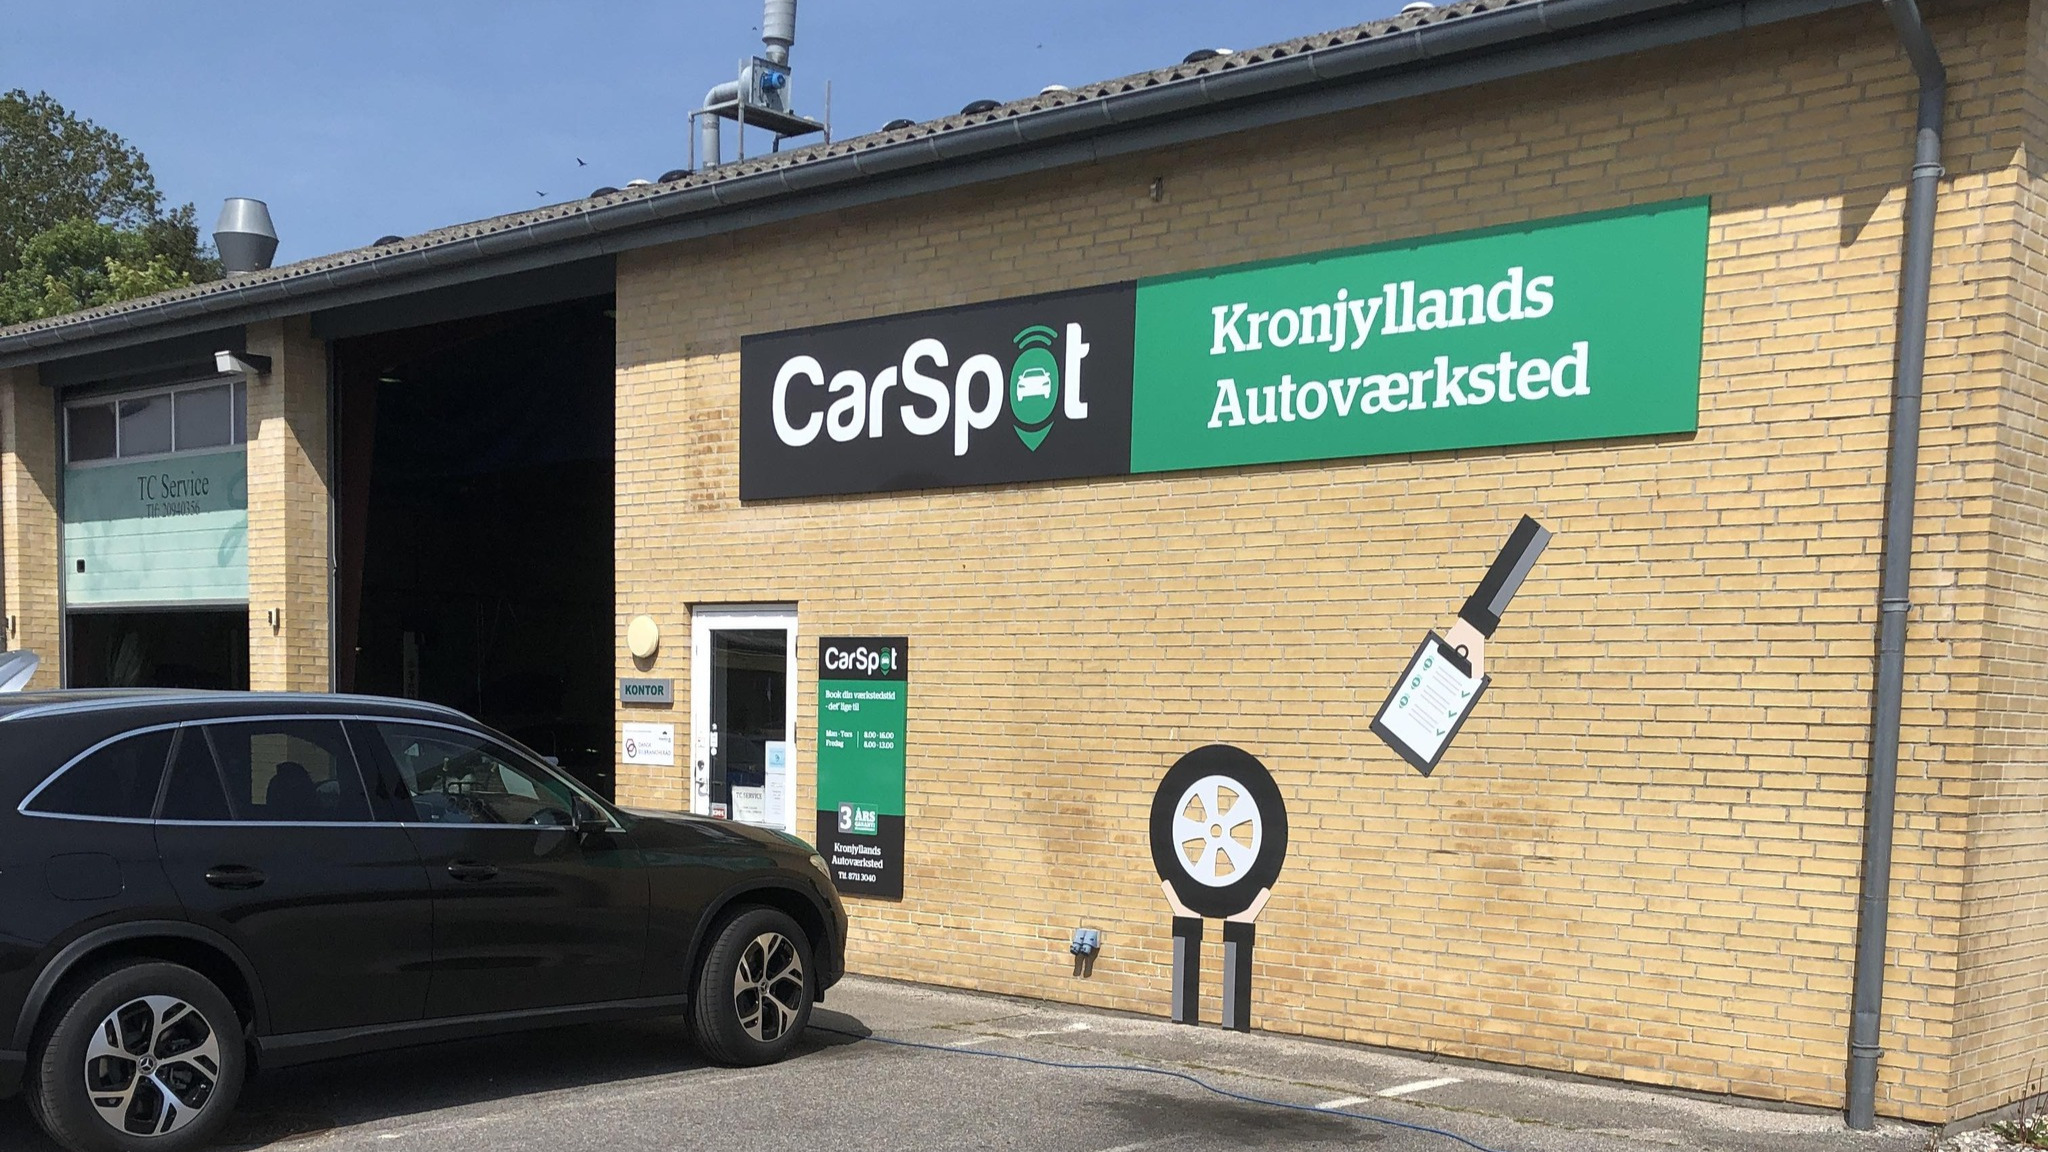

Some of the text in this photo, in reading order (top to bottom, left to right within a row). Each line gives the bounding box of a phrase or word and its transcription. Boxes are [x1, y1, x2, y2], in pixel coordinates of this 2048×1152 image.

[1209, 266, 1554, 355] Kronjyllands
[772, 322, 1090, 456] CarSpot
[1207, 340, 1591, 429] Autoværksted
[137, 470, 209, 500] TC Service
[825, 646, 898, 676] CarSpot
[625, 684, 664, 696] KONTOR
[825, 689, 896, 700] Book din værkstedstid
[841, 702, 852, 712] lige
[852, 702, 860, 711] til
[825, 729, 838, 737] Man
[863, 731, 876, 739] 8.00
[825, 739, 844, 748] Fredag
[840, 805, 876, 830] 3 ÅRS
[834, 842, 882, 856] Kronjyllands
[831, 855, 884, 869] Autoværksted
[860, 873, 877, 882] 3040
